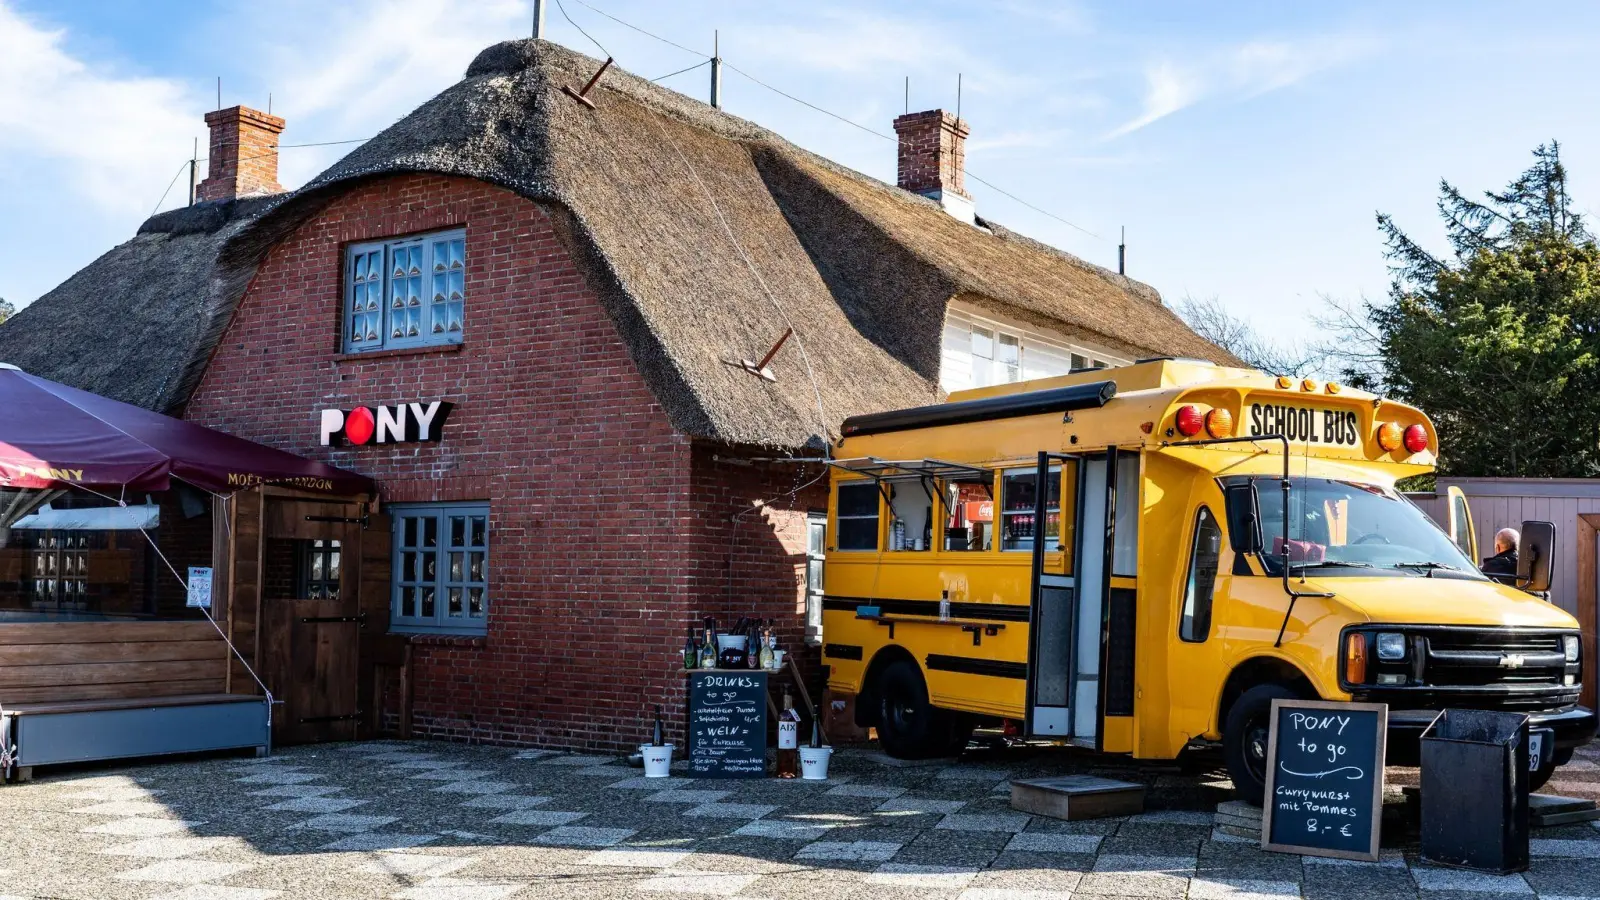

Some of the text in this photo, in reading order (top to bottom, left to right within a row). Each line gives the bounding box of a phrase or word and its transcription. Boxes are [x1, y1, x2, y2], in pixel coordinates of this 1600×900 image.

[320, 401, 442, 446] PONY
[1251, 403, 1356, 446] SCHOOL BUS
[704, 675, 753, 688] DRINKS
[722, 691, 737, 702] go
[707, 725, 740, 737] WEIN
[780, 724, 796, 732] AIX
[1289, 712, 1351, 736] PONY
[1297, 737, 1347, 763] to go
[1280, 801, 1357, 817] mit Pommes
